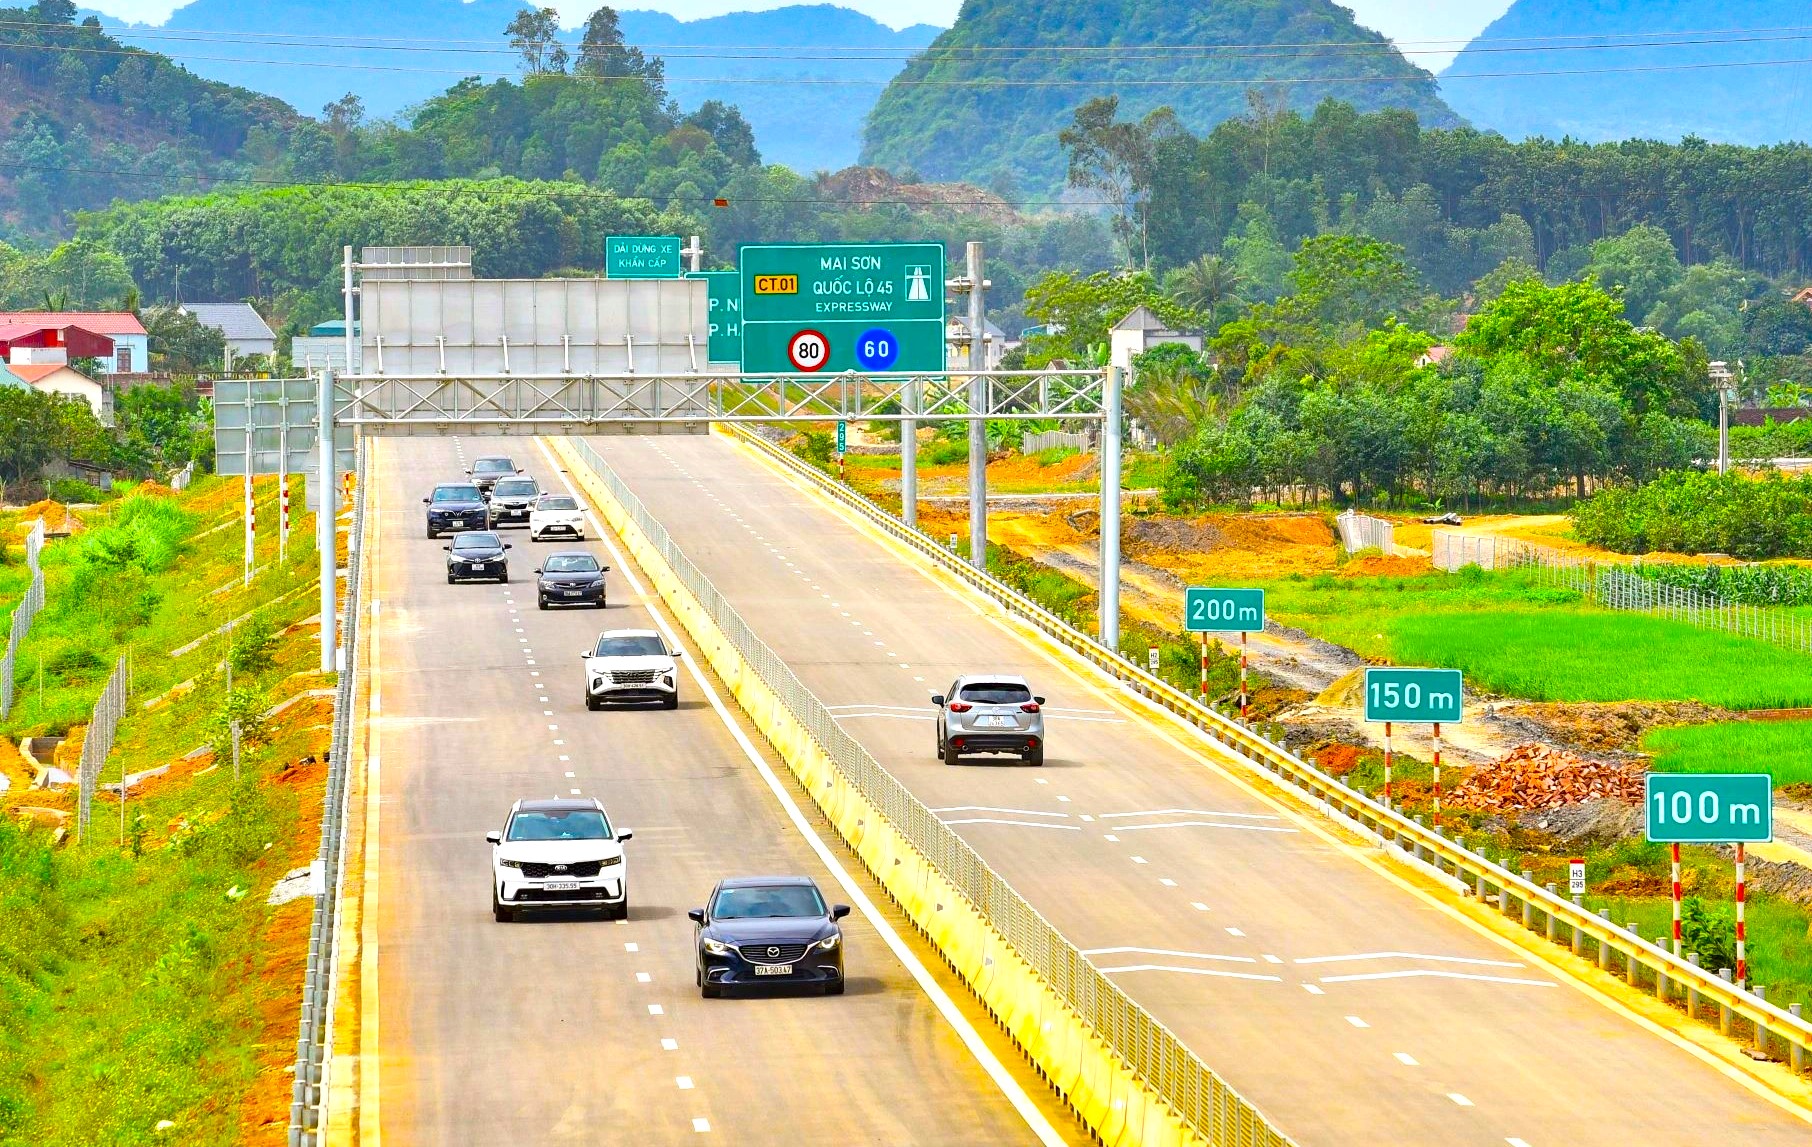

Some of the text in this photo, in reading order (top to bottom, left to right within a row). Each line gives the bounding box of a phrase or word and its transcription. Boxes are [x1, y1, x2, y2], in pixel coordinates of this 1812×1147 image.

[661, 245, 672, 253] XE
[648, 256, 667, 267] CẤP
[820, 255, 881, 270] MAI SƠN
[758, 278, 795, 291] CT.01
[813, 275, 893, 297] QUỐC LỘ 45
[815, 302, 893, 312] EXPRESSWAY
[799, 343, 819, 359] 80
[864, 340, 889, 358] 60
[1192, 599, 1257, 621] 200 m
[1371, 682, 1454, 709] 150 m
[1653, 790, 1761, 825] 100 m
[1572, 869, 1583, 878] H3
[1571, 881, 1584, 889] 295
